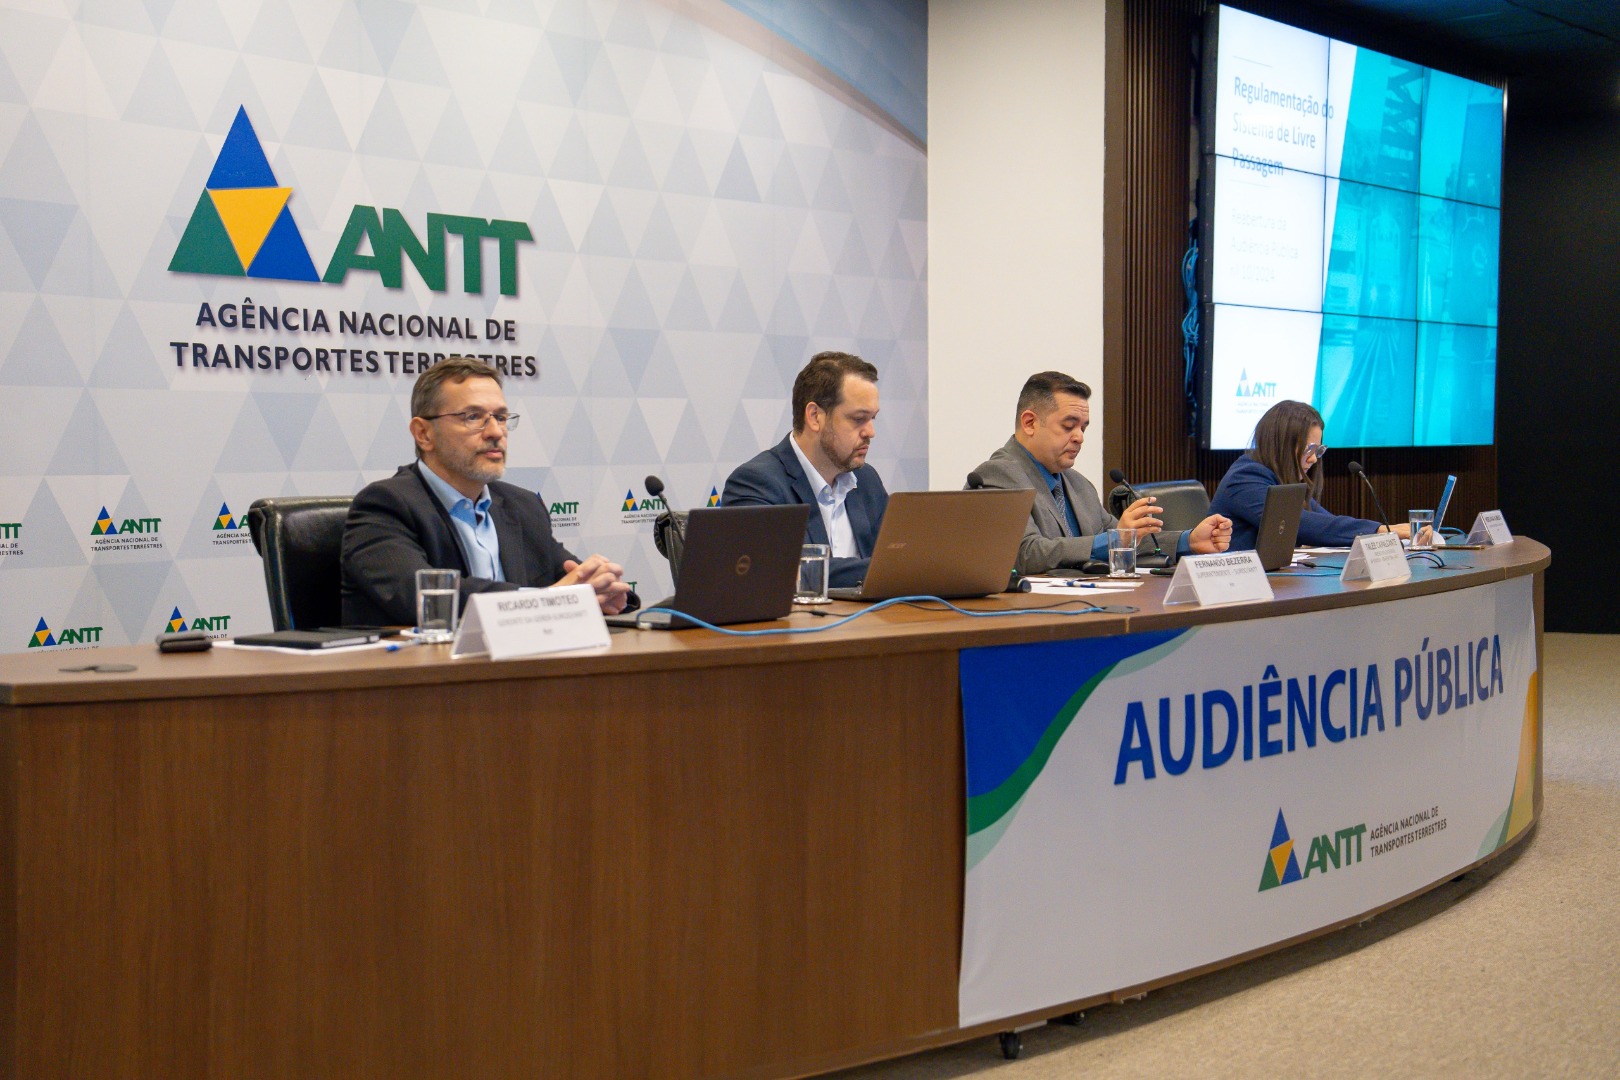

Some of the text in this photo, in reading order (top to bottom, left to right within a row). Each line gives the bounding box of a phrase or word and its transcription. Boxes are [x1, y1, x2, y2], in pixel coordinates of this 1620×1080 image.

[1234, 76, 1334, 119] Regulamentação do
[1277, 122, 1290, 143] de
[1292, 125, 1316, 149] Livre
[1232, 147, 1284, 178] Passagem
[321, 204, 534, 296] ANTT
[196, 297, 516, 341] AGÊNCIA NACIONAL DE
[170, 342, 537, 376] TRANSPORTES TERTRES
[1252, 382, 1277, 397] ANTT
[550, 502, 579, 514] ANTT
[0, 523, 22, 539] TT
[118, 518, 161, 534] ANTT
[91, 544, 129, 552] TRANSPORTES
[1195, 556, 1253, 569] FERNANDO BEZERRA
[497, 594, 579, 612] RICARDO TIMOTEO
[58, 627, 103, 645] ANTT
[191, 615, 231, 631] ANTT
[1114, 634, 1503, 785] AUDIÊNCIA PÚBLICA
[1370, 806, 1439, 842] AGÊNCIA NACIONAL DE
[1303, 823, 1367, 879] ANTT
[1370, 818, 1447, 858] TRANSPORTES TERRESTRES
